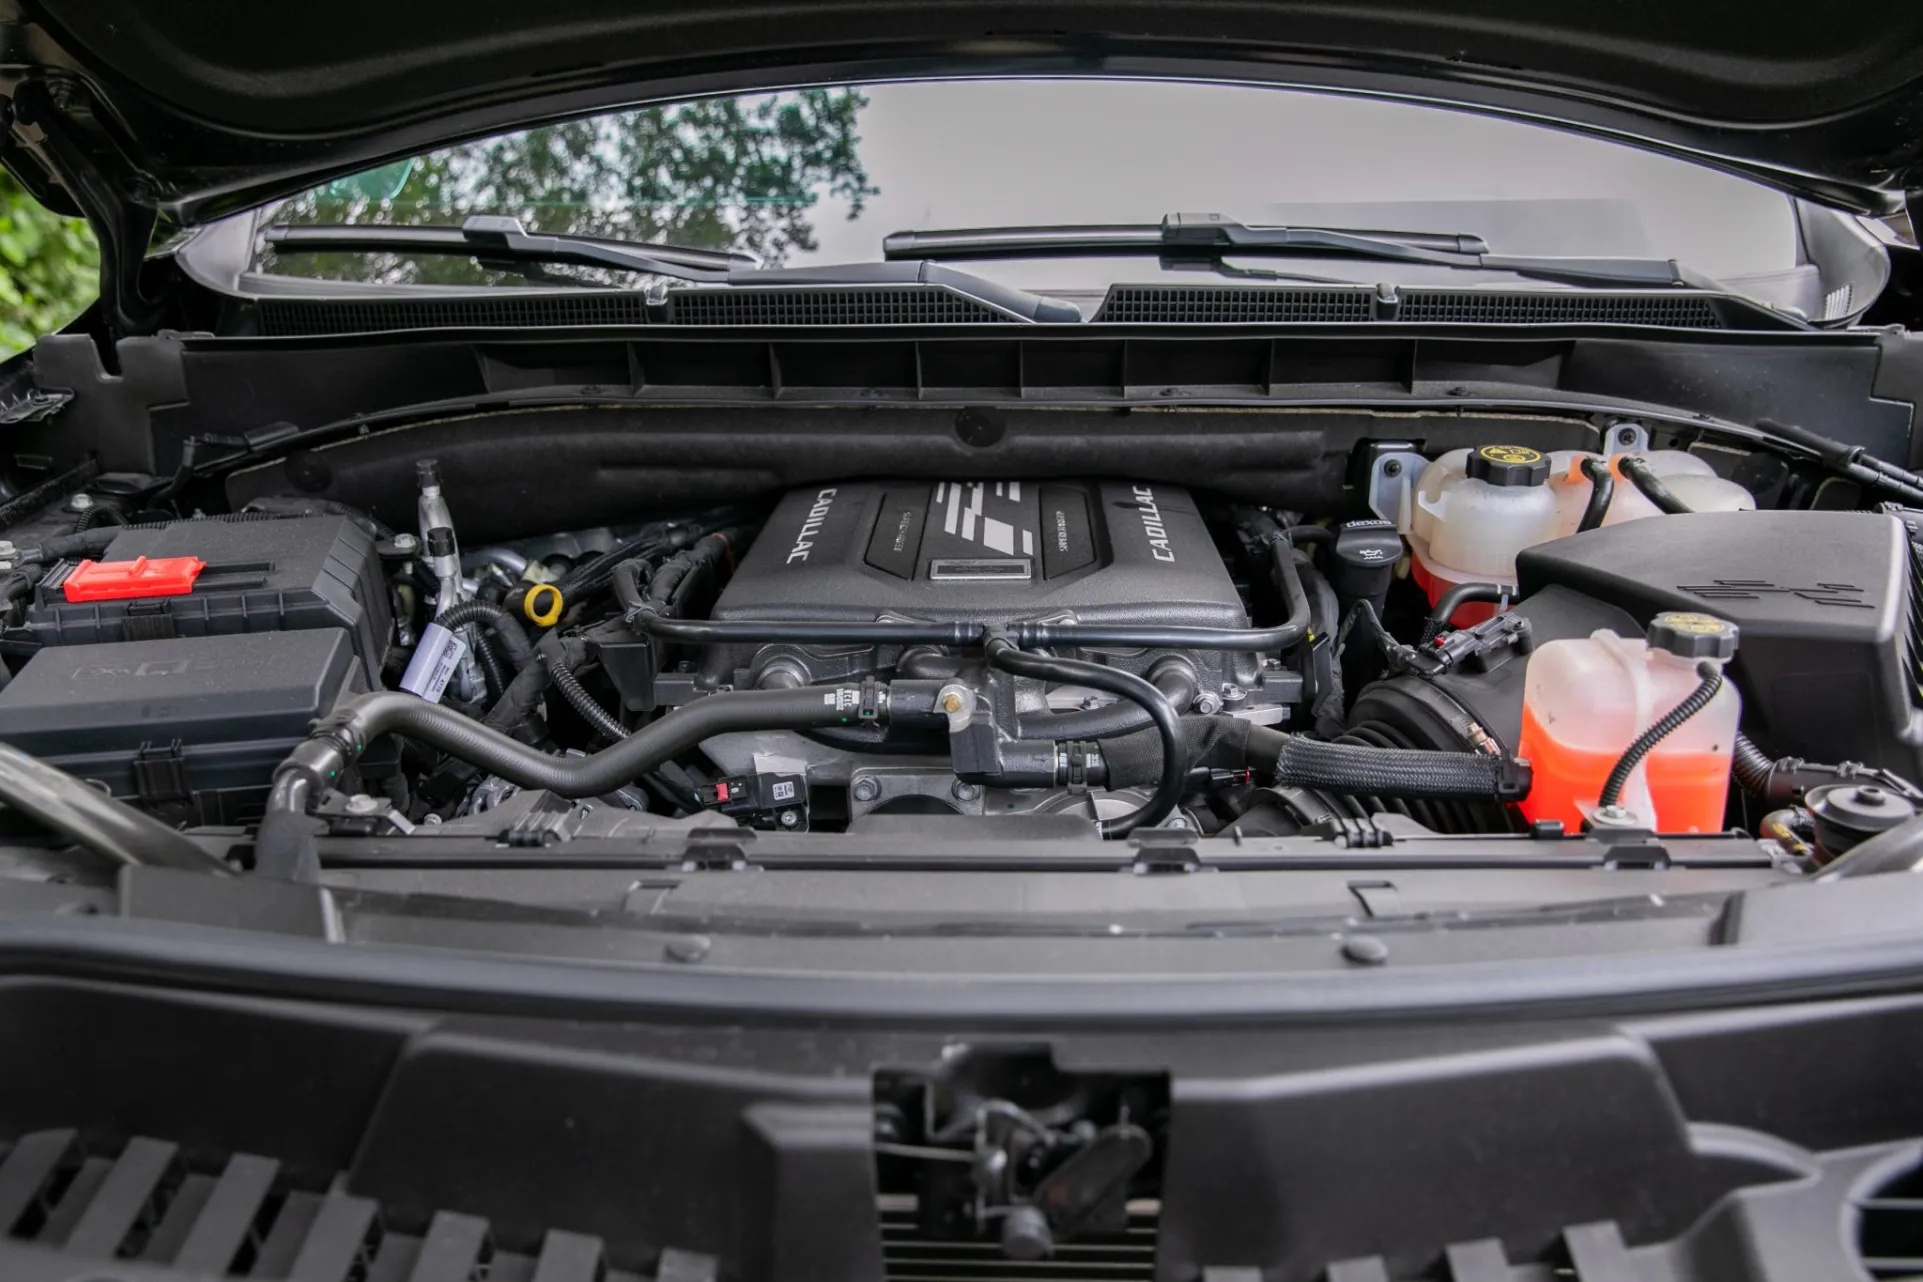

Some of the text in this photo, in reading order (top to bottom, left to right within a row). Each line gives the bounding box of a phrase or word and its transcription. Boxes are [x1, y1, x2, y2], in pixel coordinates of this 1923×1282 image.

[786, 488, 837, 565] CADILLAC
[1132, 485, 1175, 563] CADILLAC
[1346, 520, 1392, 528] dexos
